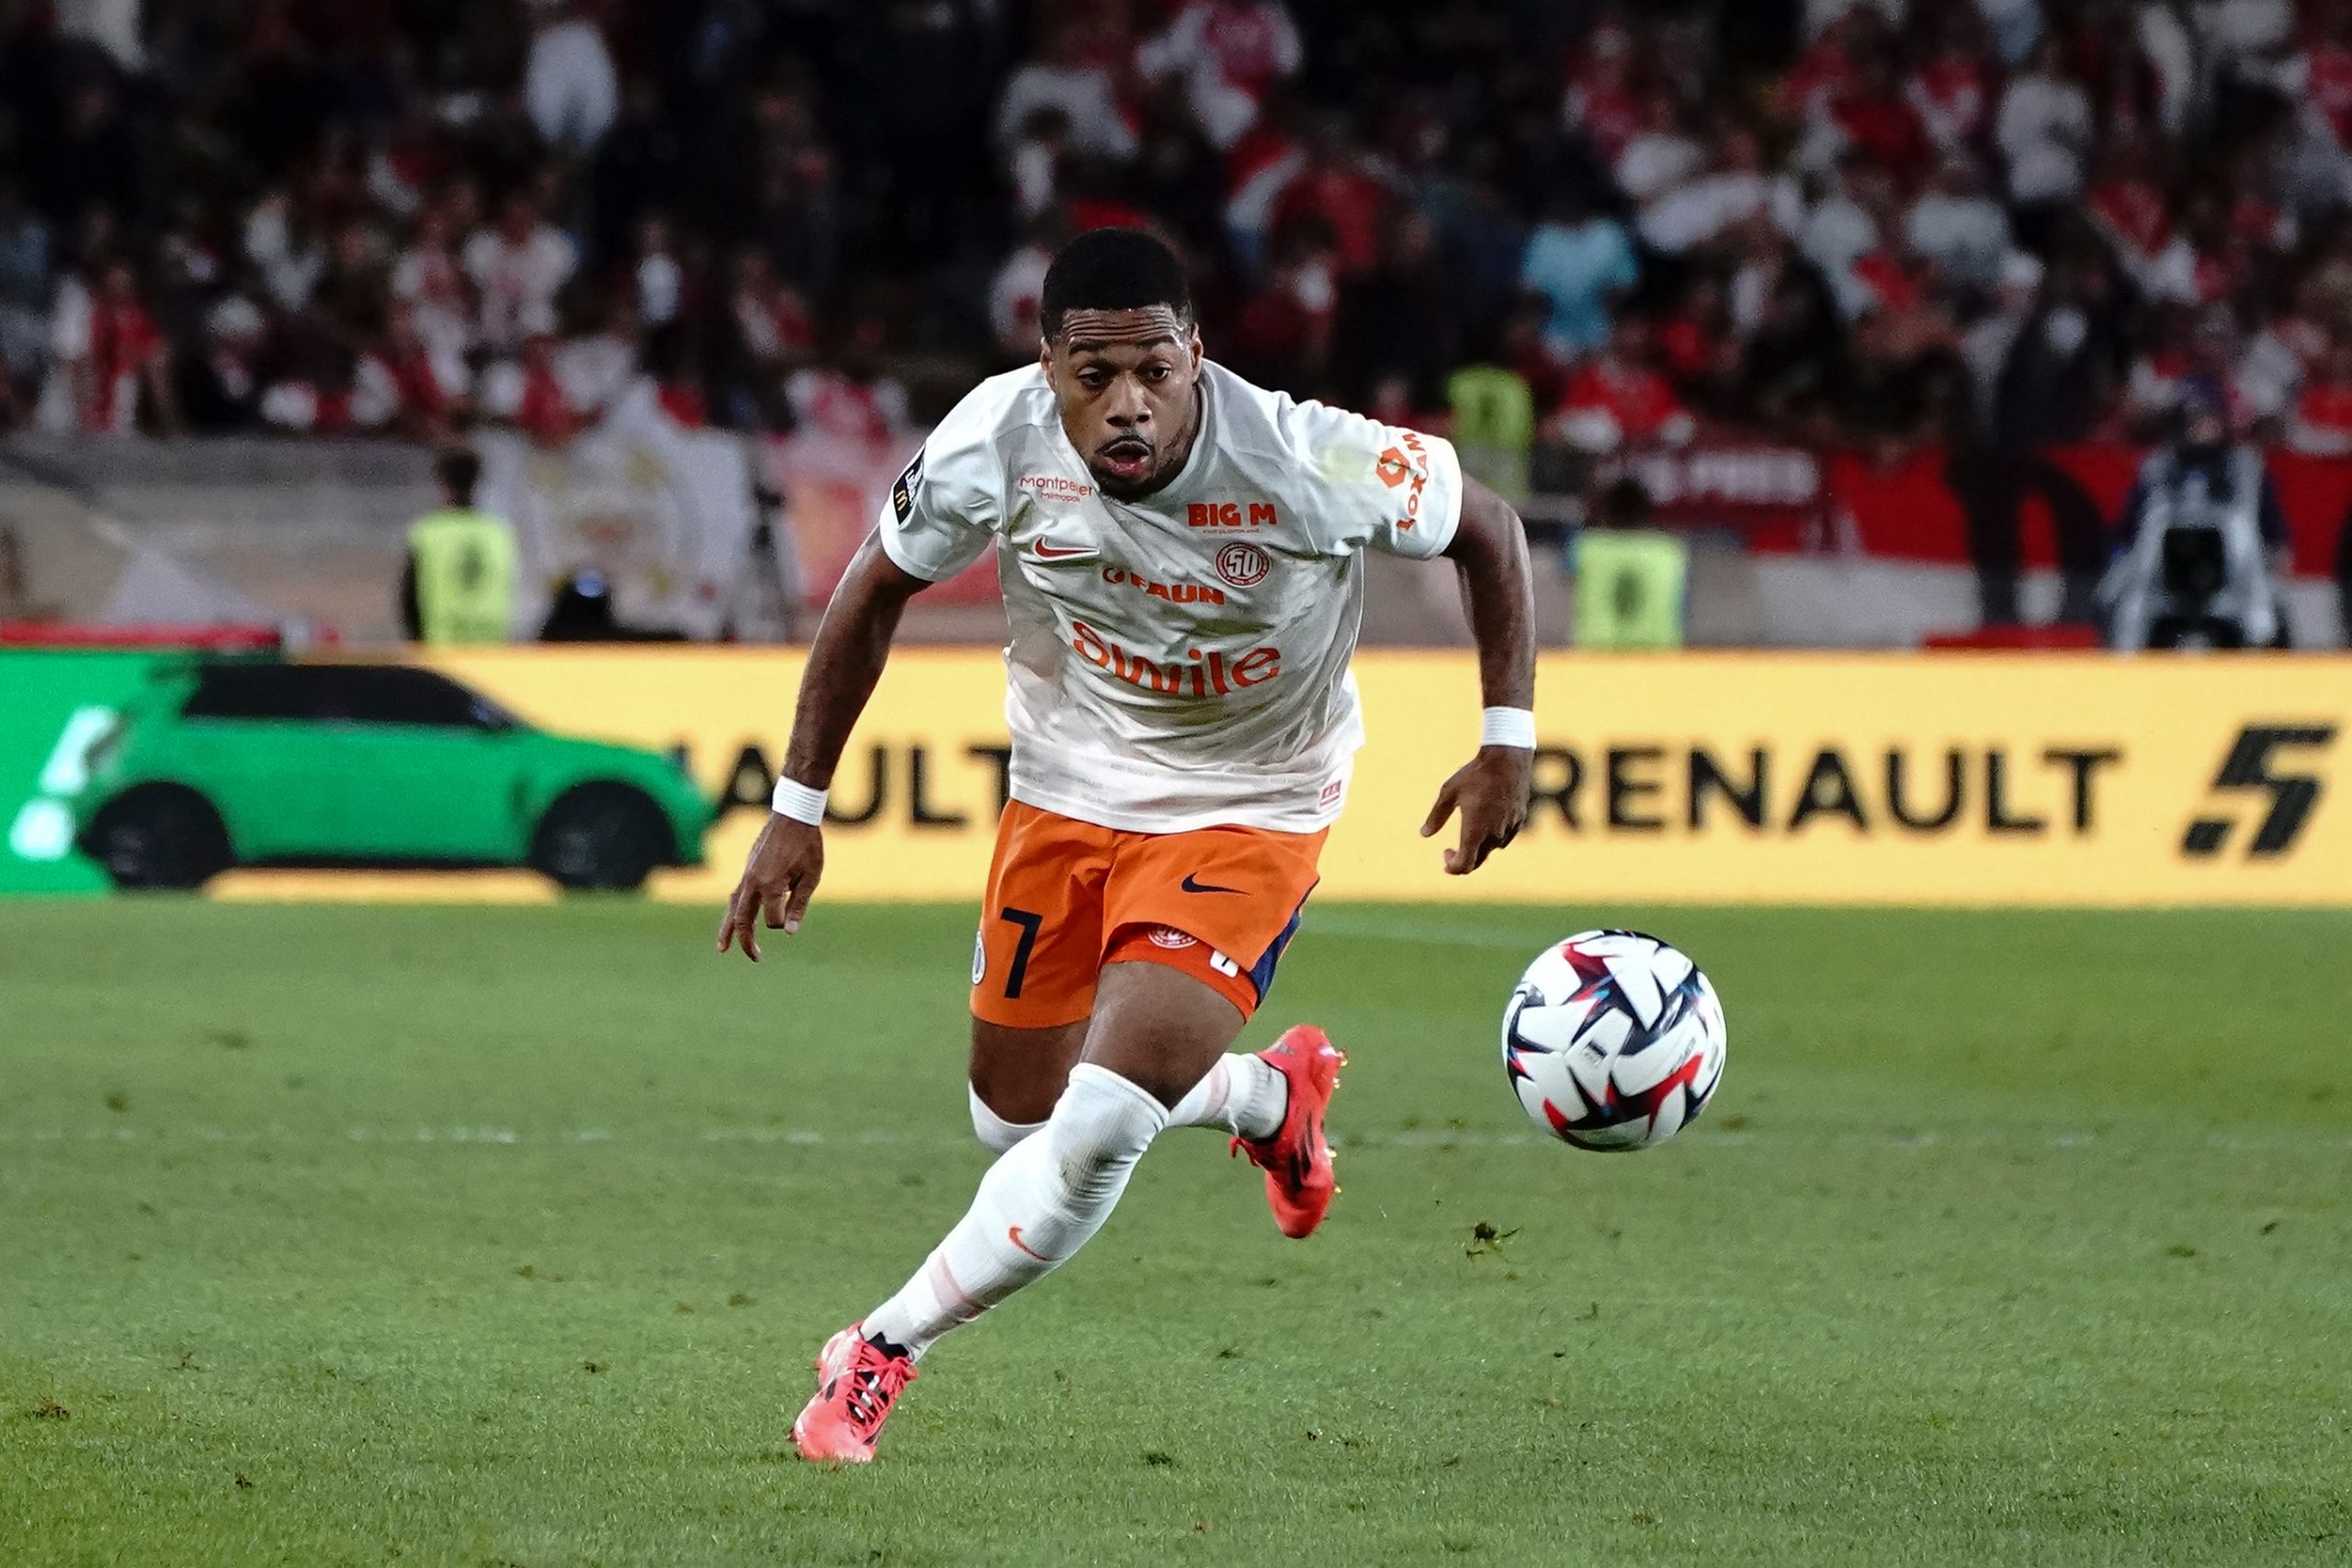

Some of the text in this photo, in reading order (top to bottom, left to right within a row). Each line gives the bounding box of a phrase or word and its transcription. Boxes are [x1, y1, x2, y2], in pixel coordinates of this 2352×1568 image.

[1187, 502, 1277, 526] BIG M
[1396, 433, 1429, 530] LOXAM
[1130, 570, 1226, 606] FAUN
[1225, 549, 1261, 578] 50
[1072, 620, 1281, 697] Swile
[1526, 746, 2121, 833] RENAULT
[1000, 906, 1044, 999] 7
